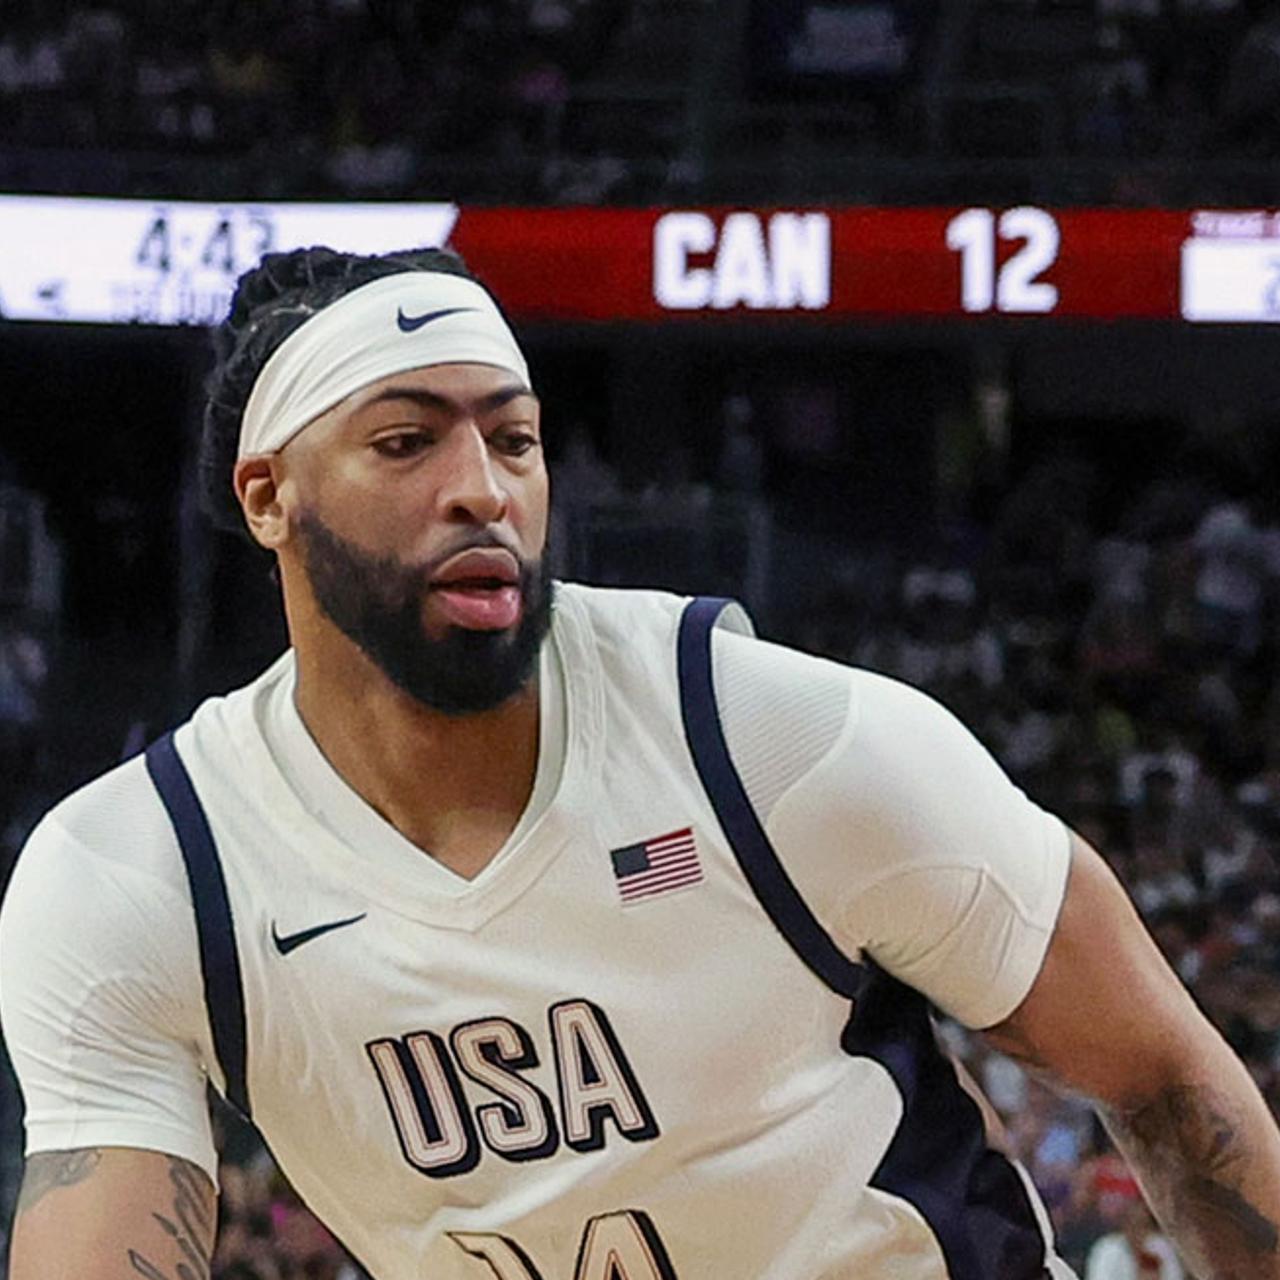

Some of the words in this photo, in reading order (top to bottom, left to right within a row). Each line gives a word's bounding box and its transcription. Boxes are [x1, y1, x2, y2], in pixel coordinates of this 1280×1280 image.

[653, 212, 831, 309] CAN
[945, 206, 1060, 312] 12
[365, 998, 661, 1178] USA
